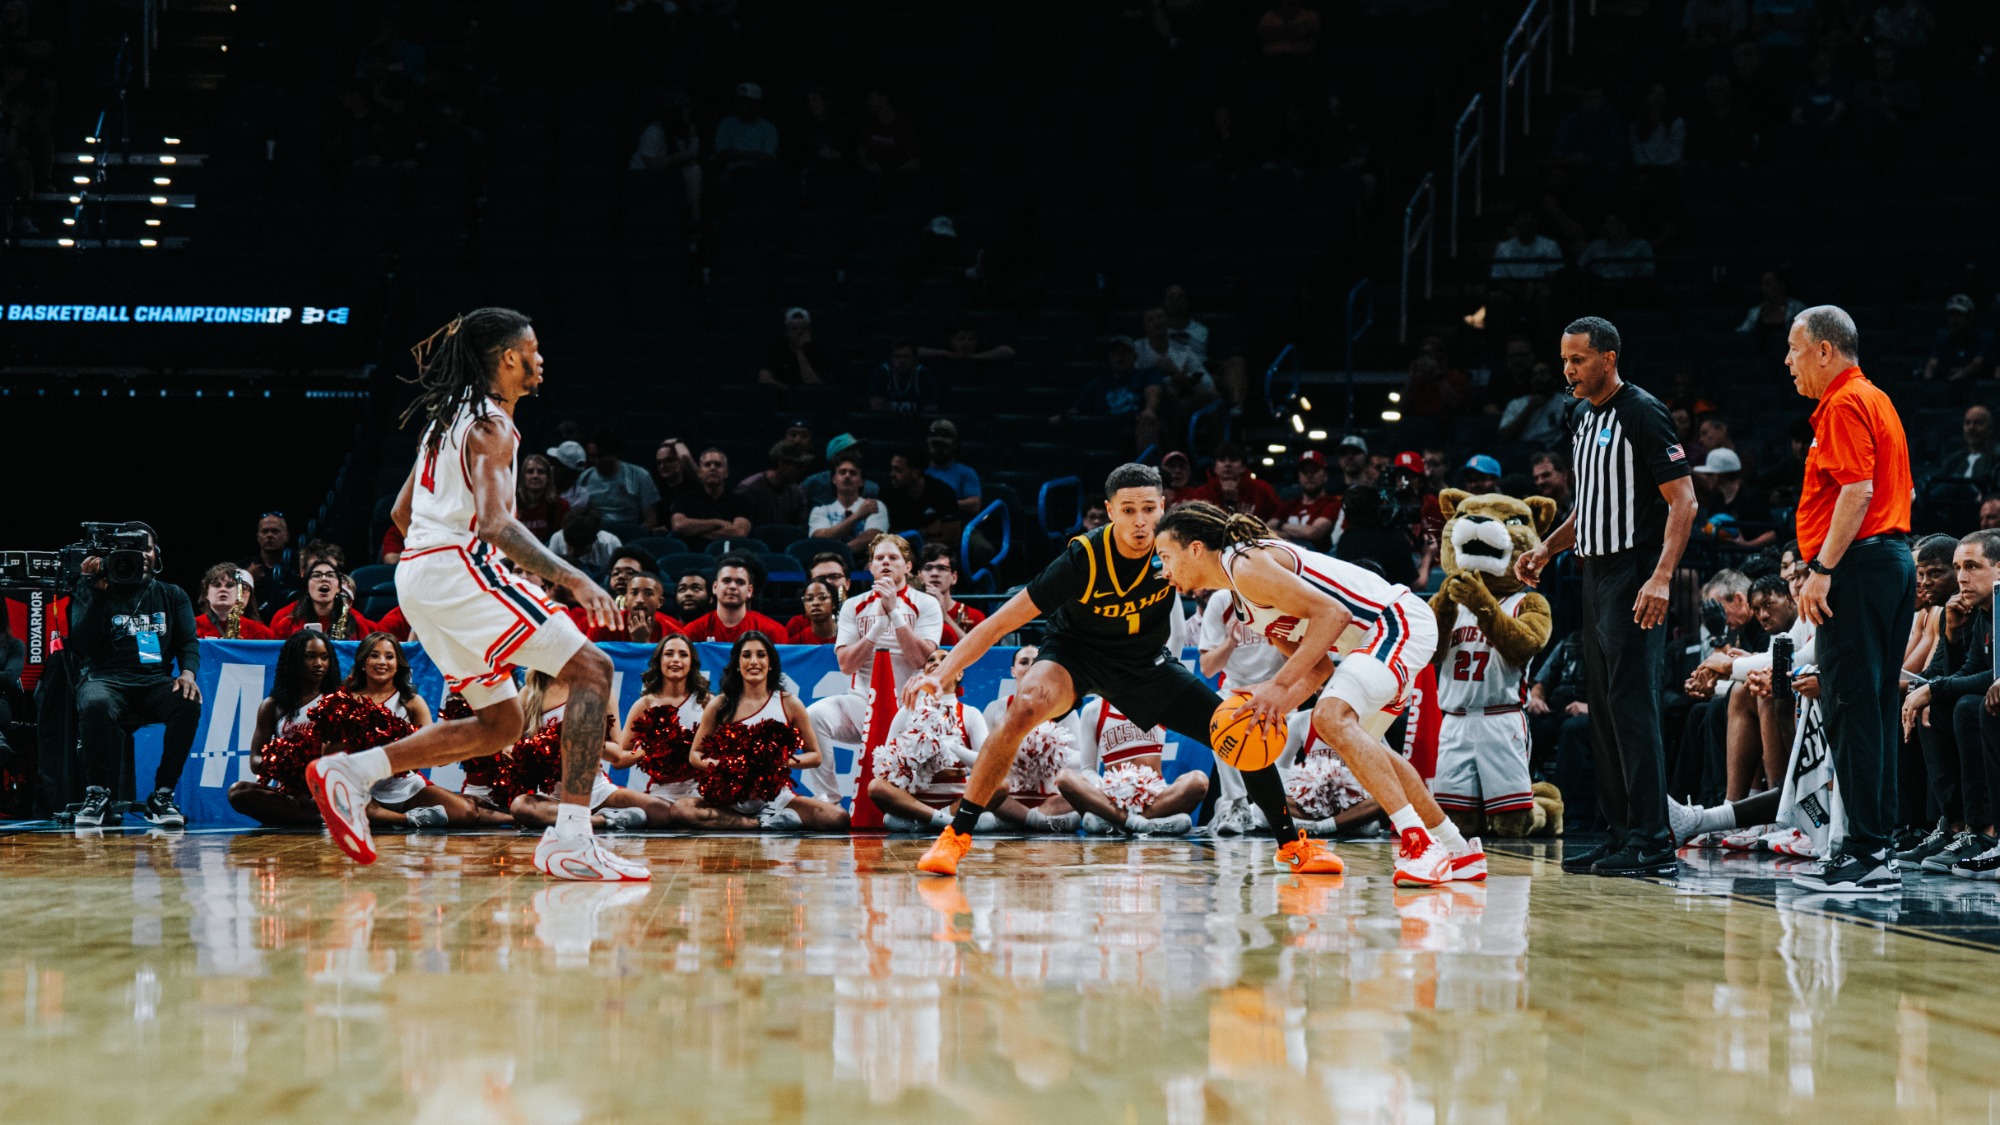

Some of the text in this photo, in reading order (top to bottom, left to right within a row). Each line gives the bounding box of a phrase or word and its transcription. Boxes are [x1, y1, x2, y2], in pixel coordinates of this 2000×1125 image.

[8, 305, 130, 322] BASKETBALL
[134, 306, 292, 324] CHAMPIONSHIP
[30, 591, 43, 664] BODYARMOR
[1125, 612, 1141, 635] 1
[1453, 650, 1490, 682] 27
